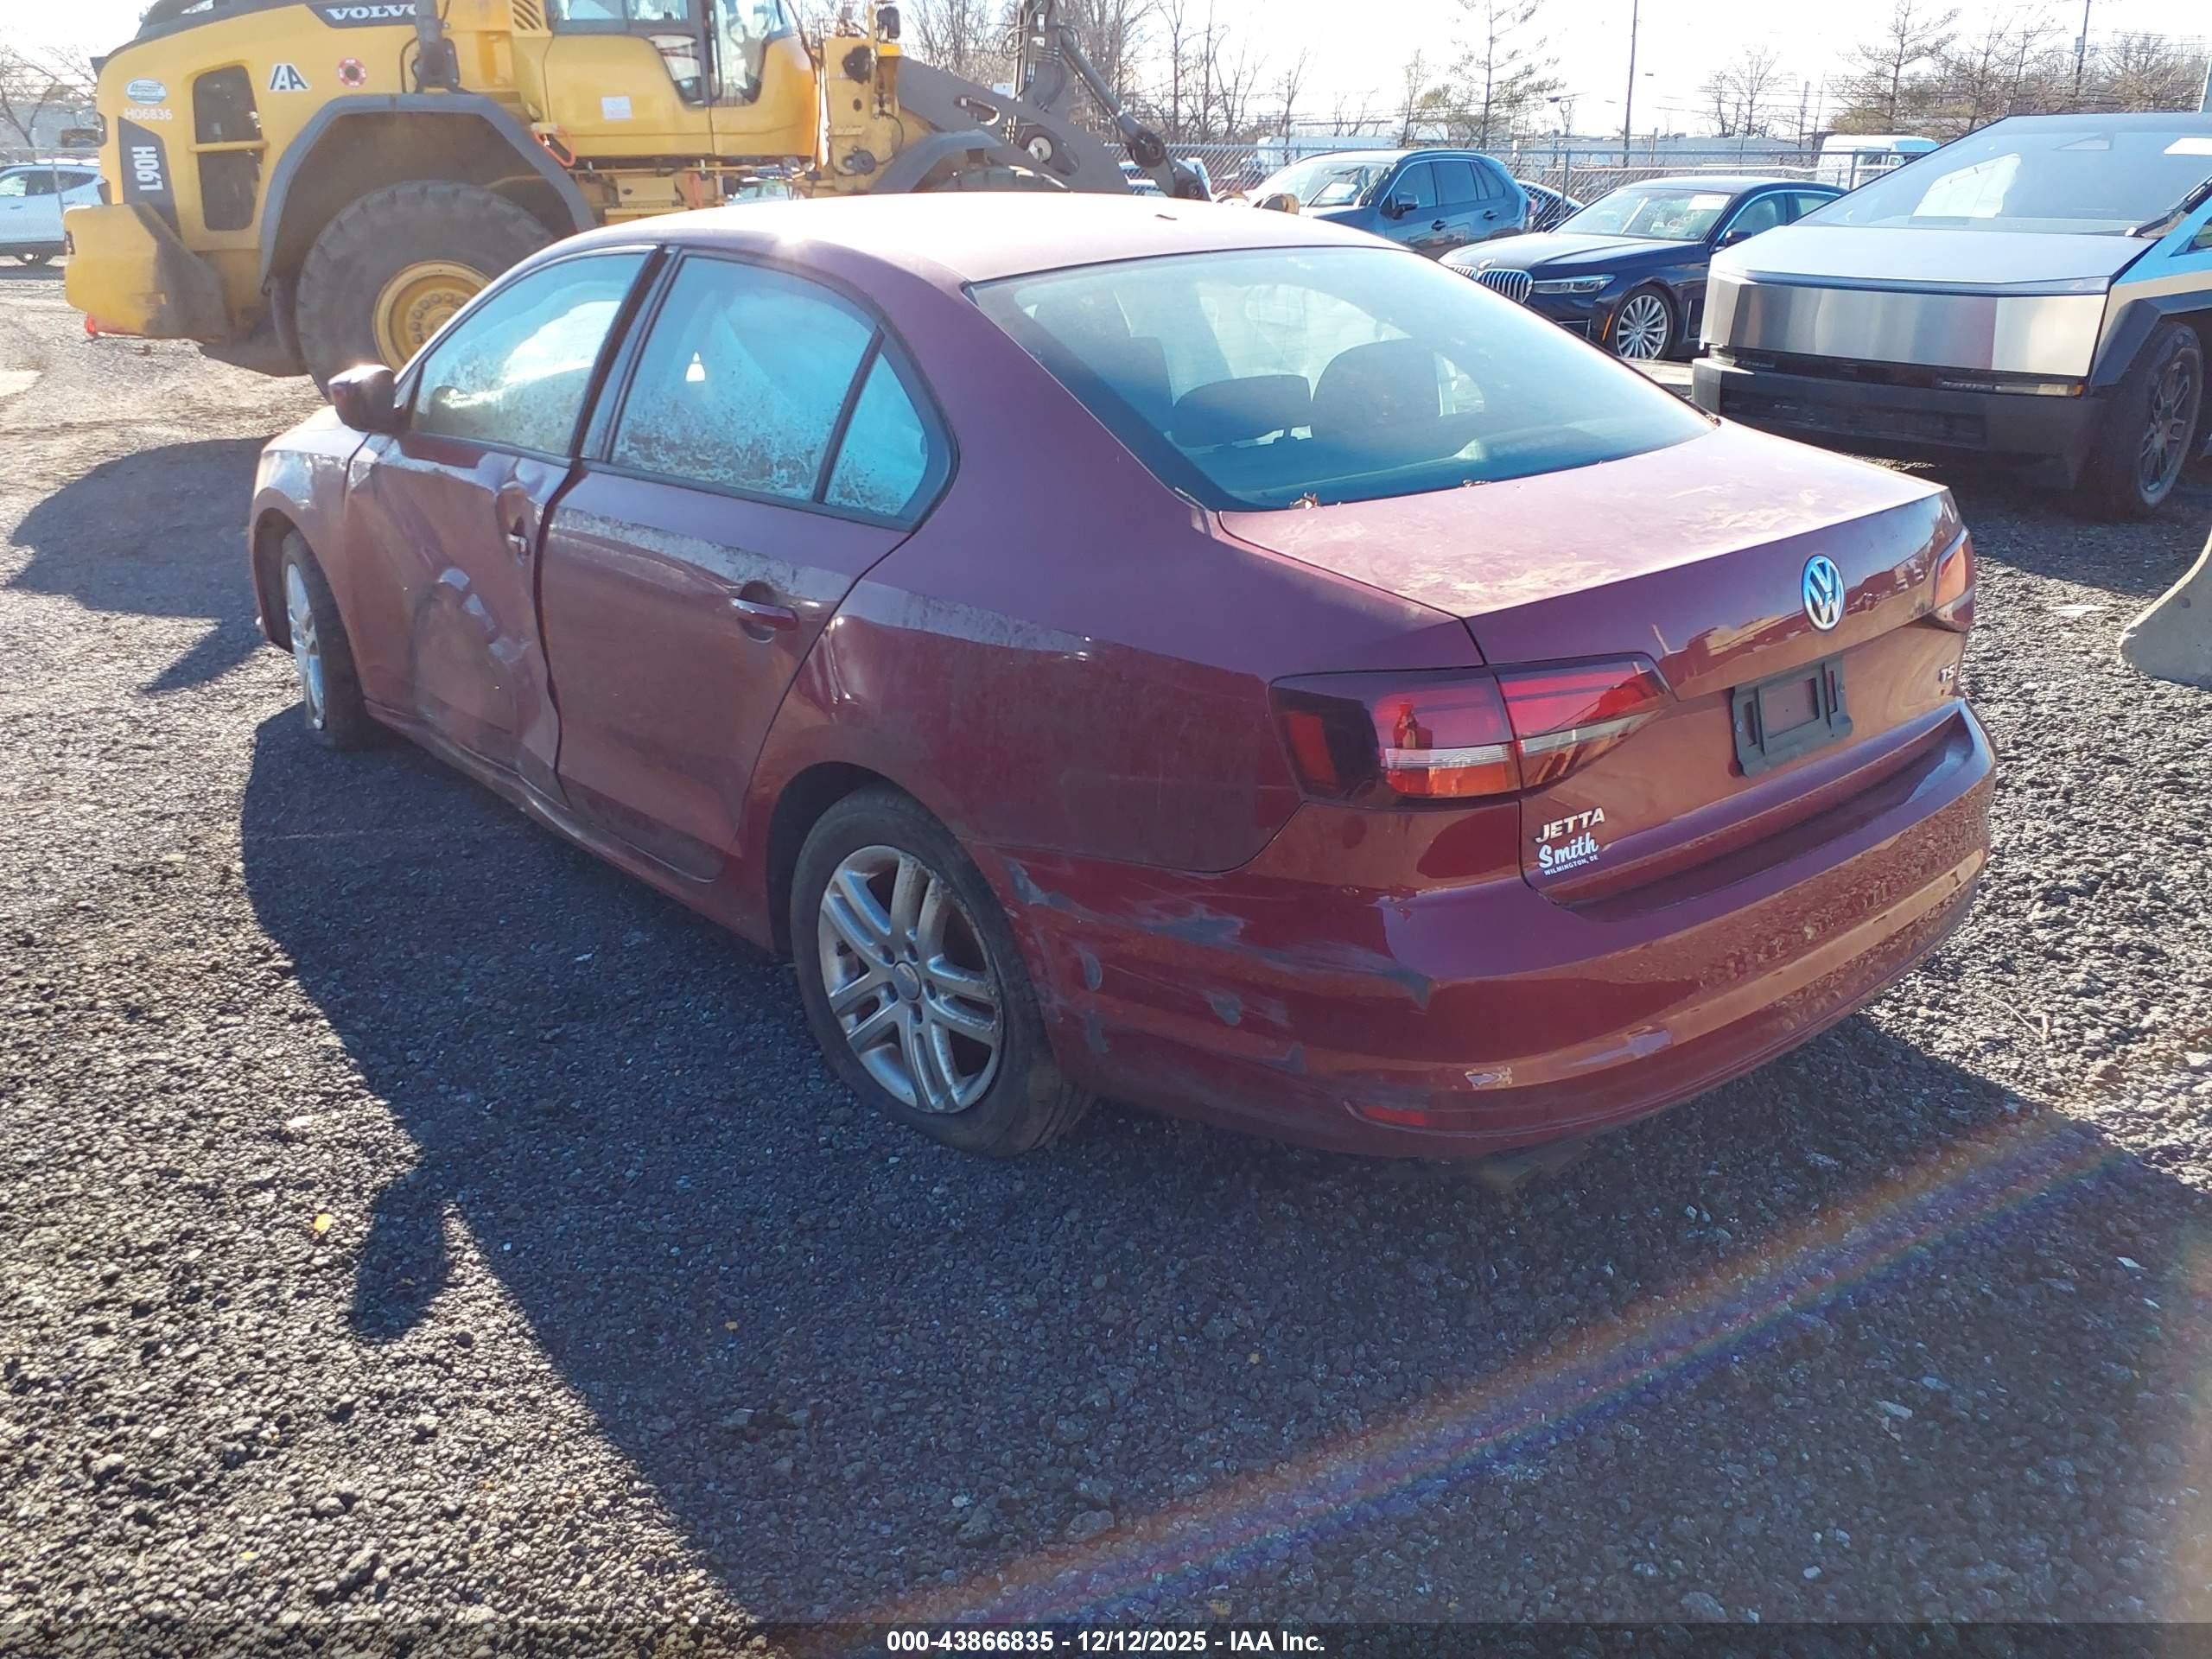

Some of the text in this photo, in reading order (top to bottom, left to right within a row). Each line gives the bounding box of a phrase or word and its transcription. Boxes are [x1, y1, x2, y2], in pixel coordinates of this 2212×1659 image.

[131, 146, 163, 190] L90H
[1535, 807, 1605, 843] JETTA
[1539, 831, 1599, 868] Smith
